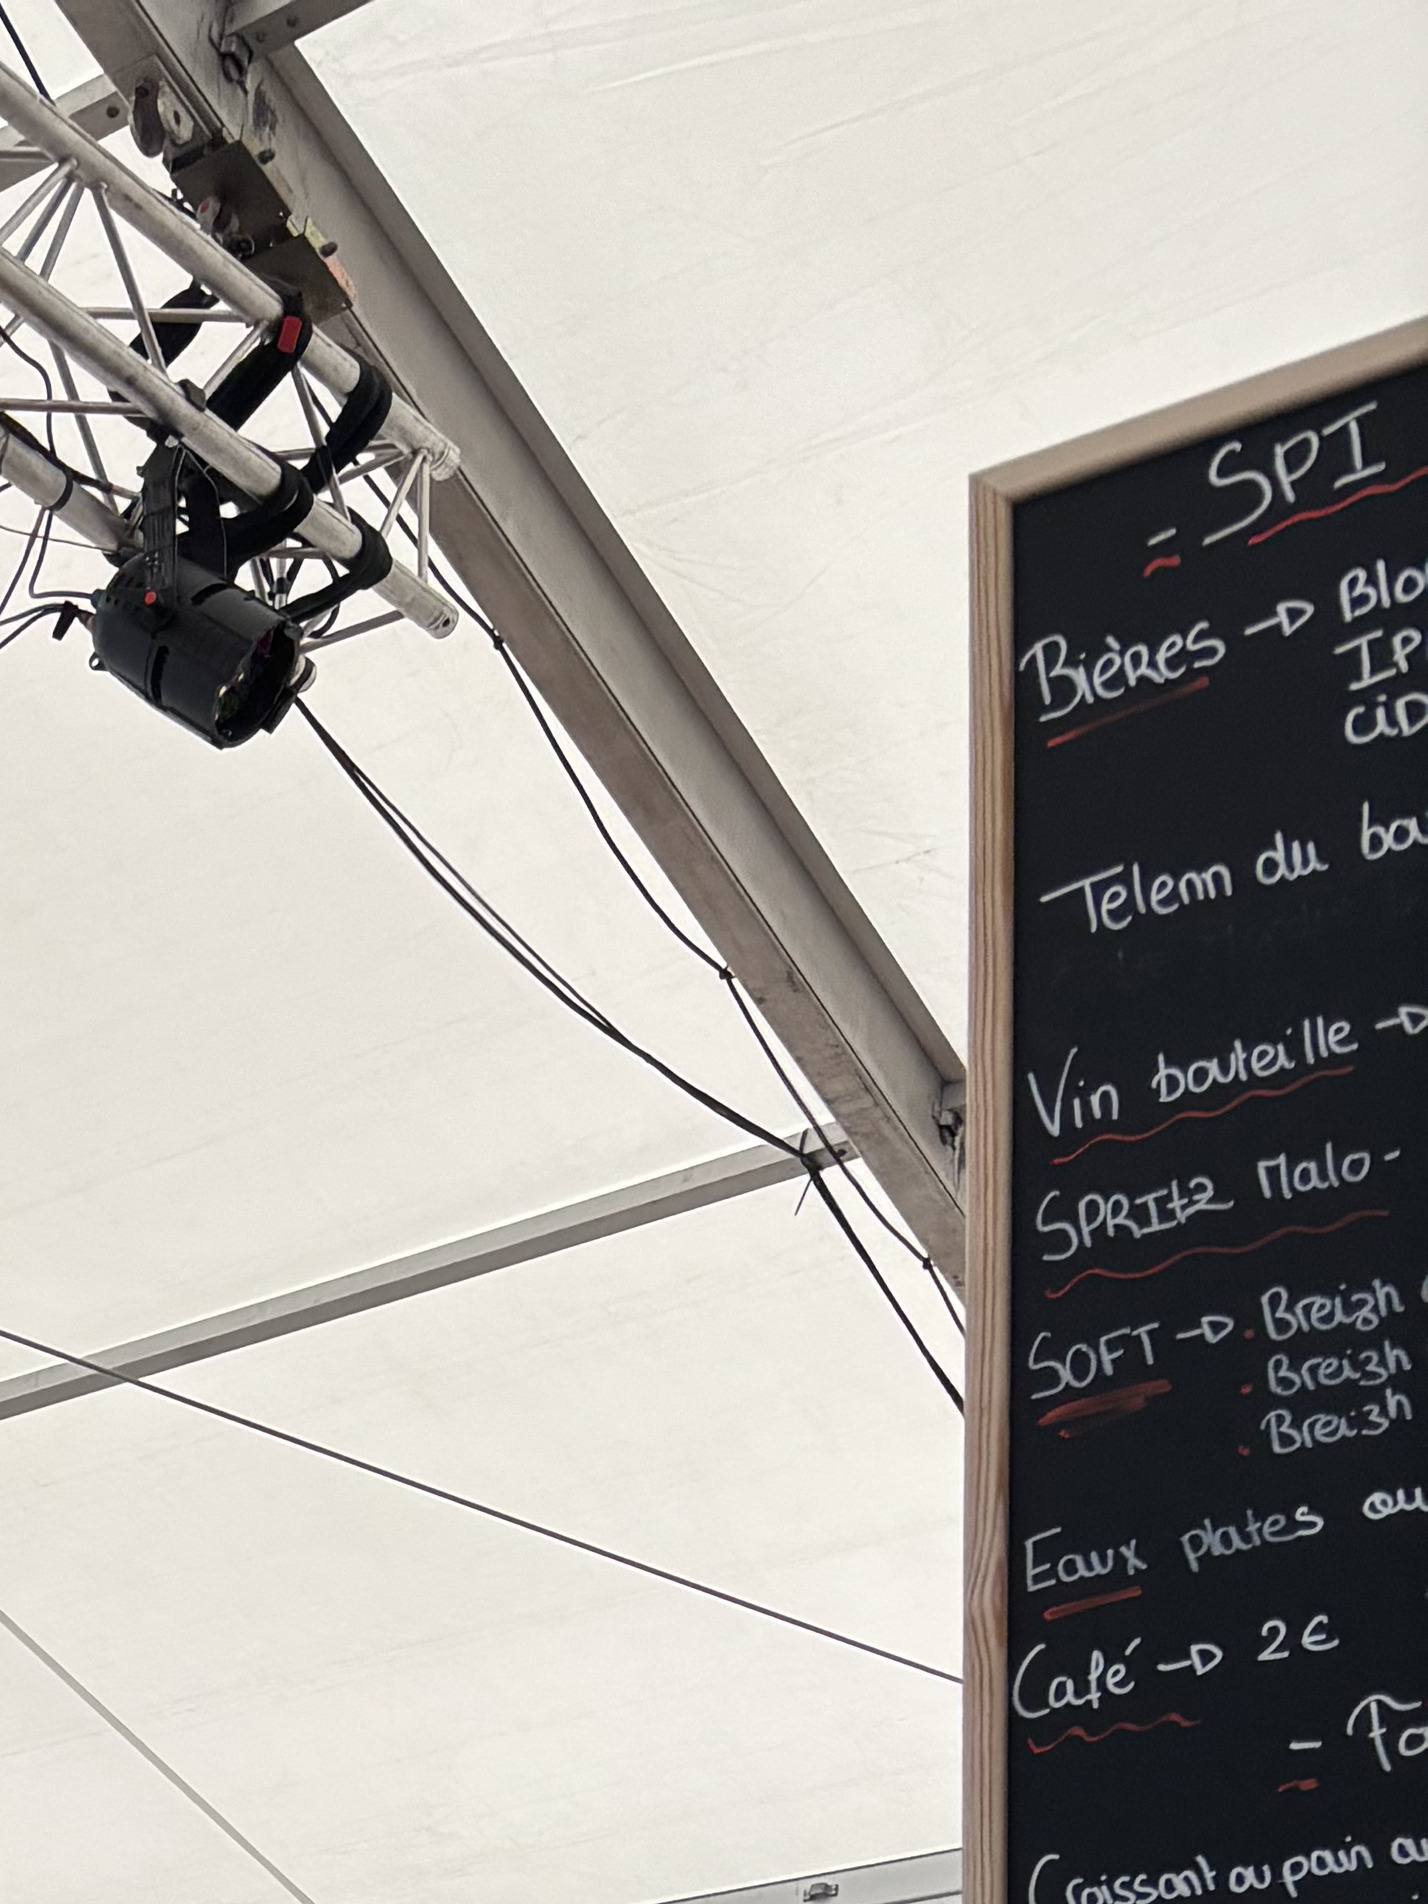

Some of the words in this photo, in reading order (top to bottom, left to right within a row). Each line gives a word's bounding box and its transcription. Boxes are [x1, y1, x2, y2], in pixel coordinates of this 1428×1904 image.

[1202, 401, 1386, 546] SPI
[1338, 558, 1428, 623] Blo
[1255, 829, 1330, 886] du
[1028, 1046, 1120, 1138] Vin
[1151, 1014, 1359, 1103] bouteille
[1028, 1321, 1161, 1400] SOFT
[1023, 1526, 1149, 1593] Eaux
[1179, 1505, 1325, 1574] plates
[1012, 1637, 1142, 1719] Café
[1279, 1835, 1374, 1899] pain
